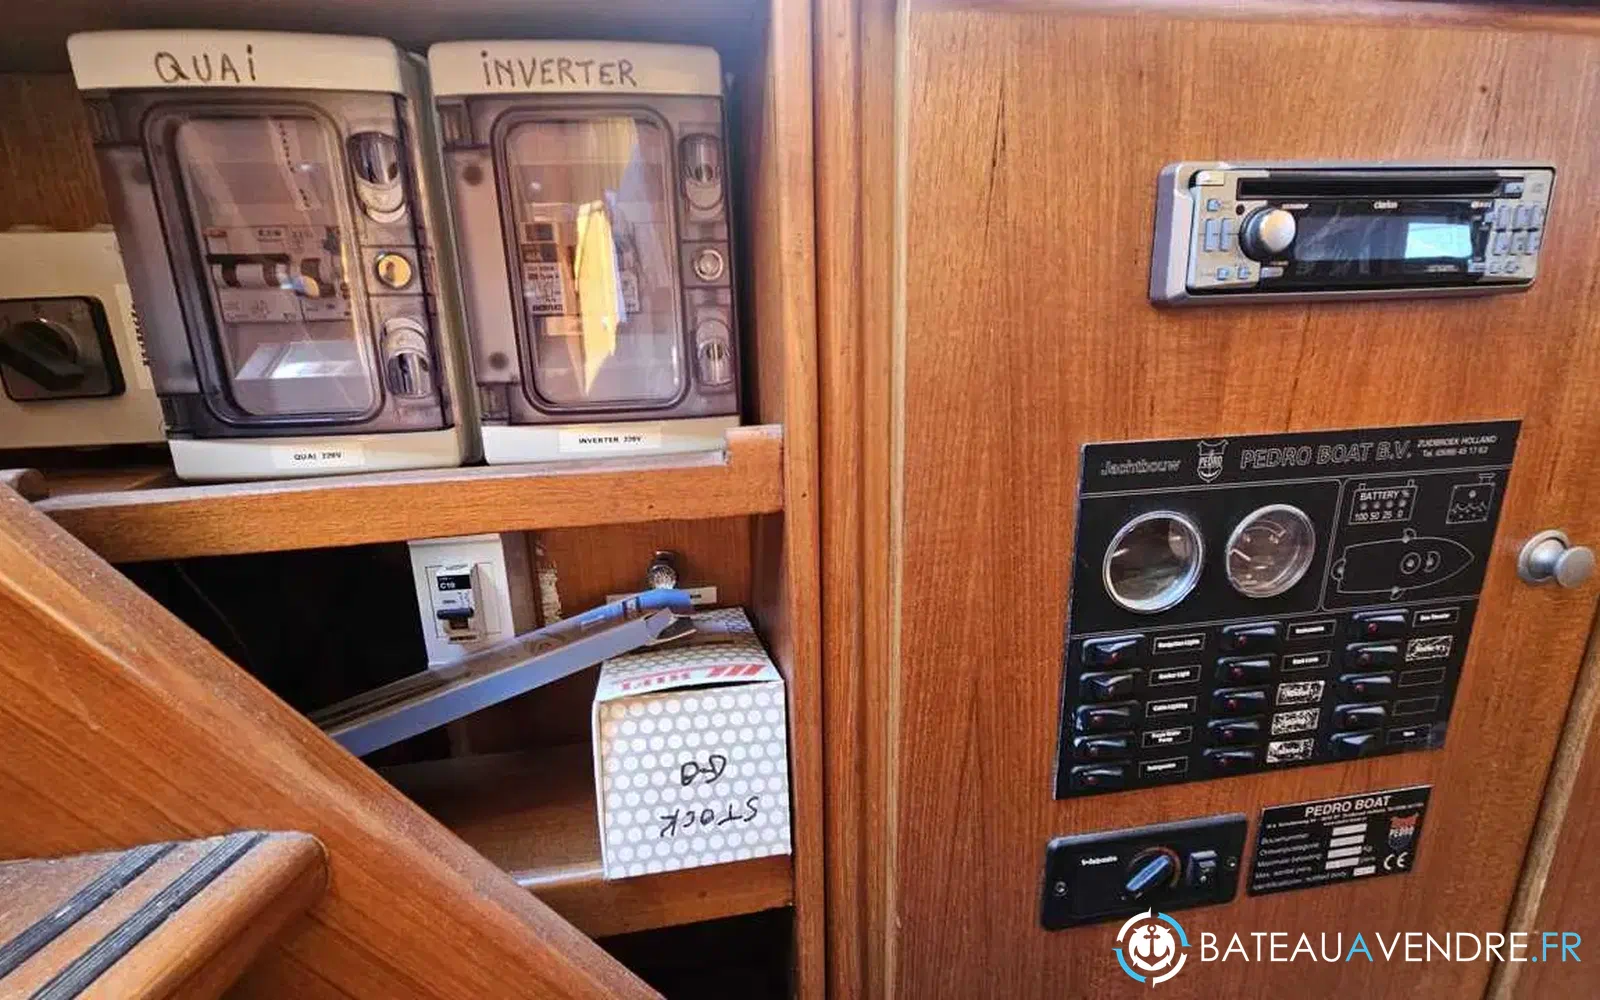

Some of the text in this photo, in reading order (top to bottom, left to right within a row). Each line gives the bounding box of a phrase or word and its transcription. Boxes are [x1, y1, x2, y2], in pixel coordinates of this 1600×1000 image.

[579, 435, 619, 444] INVERTER
[1240, 440, 1412, 470] PEDRO BOAT B.V.
[1359, 489, 1399, 501] BATTERY
[1355, 511, 1368, 521] 100
[1305, 801, 1353, 818] PEDRO
[1354, 795, 1392, 811] BOAT
[659, 795, 760, 838] STOCK
